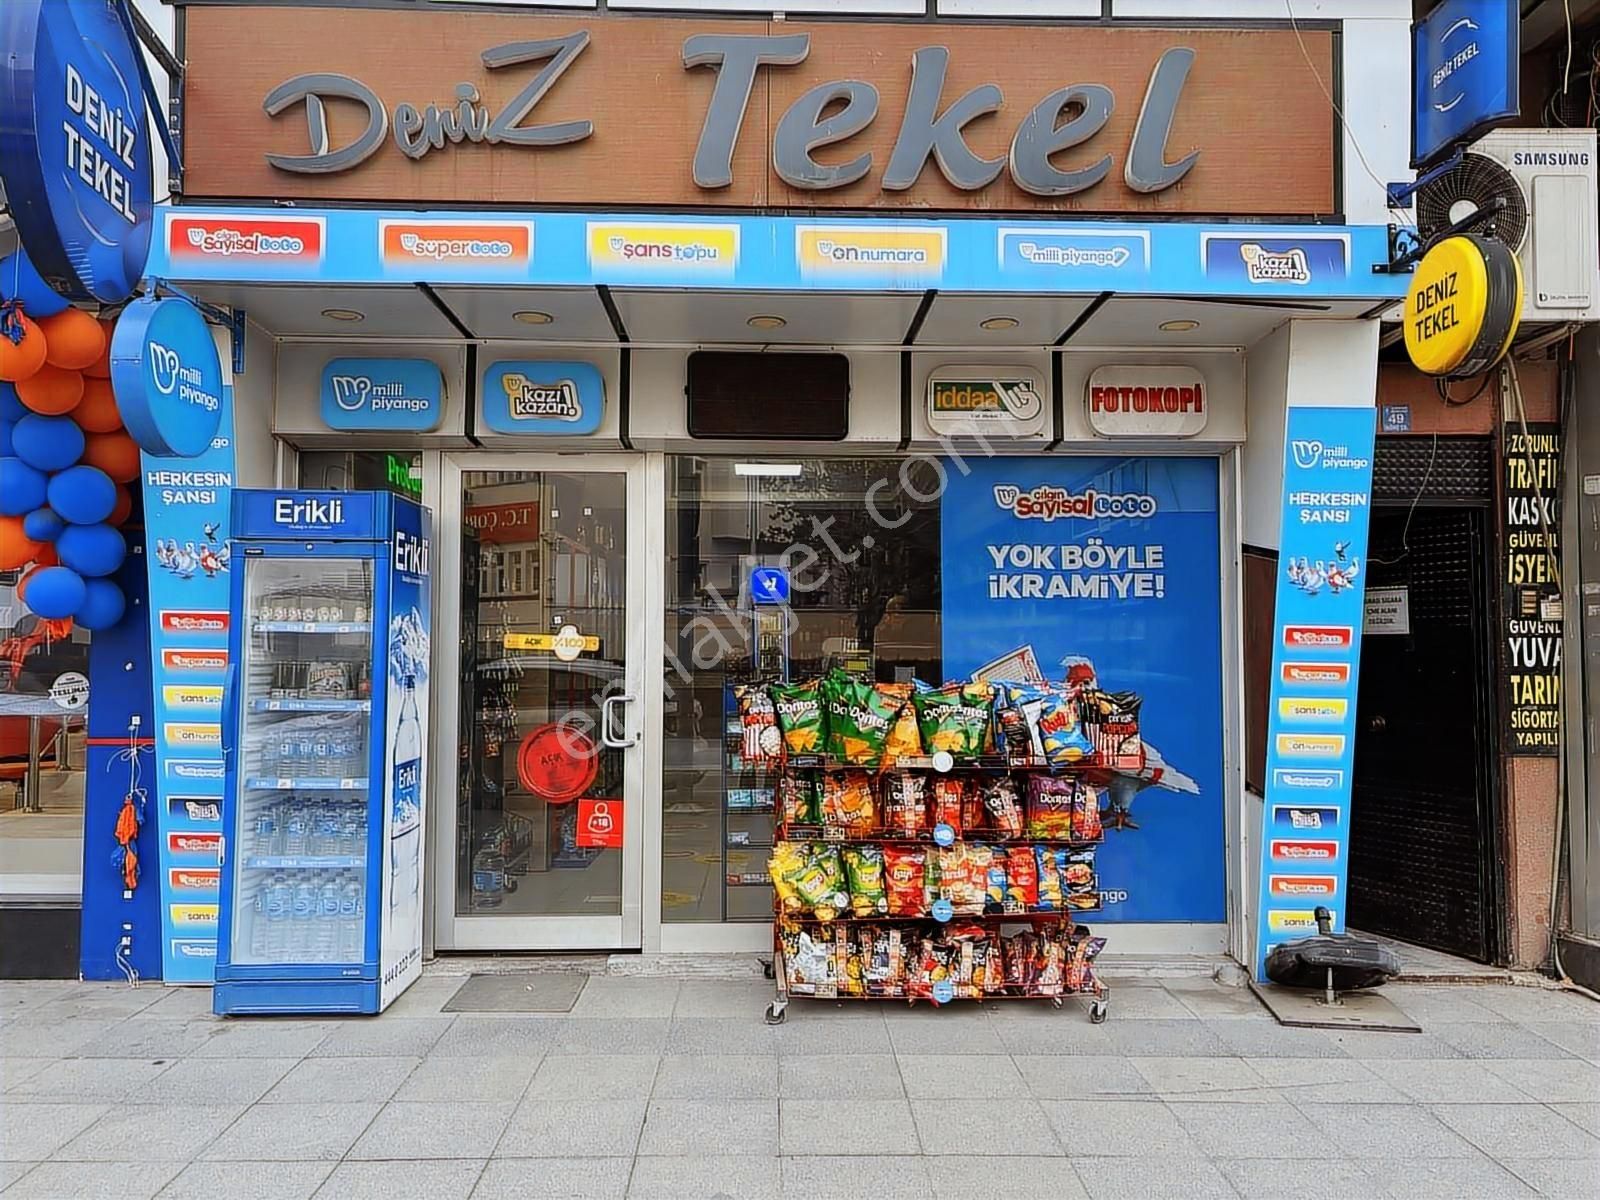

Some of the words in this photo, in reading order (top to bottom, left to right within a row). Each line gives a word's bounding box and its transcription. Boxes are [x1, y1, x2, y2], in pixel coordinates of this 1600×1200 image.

[1432, 59, 1453, 88] DENİZ
[1453, 42, 1480, 72] TEKEL
[64, 63, 136, 171] DENİZ
[682, 32, 1201, 198] Tekel
[1514, 152, 1589, 166] SAMSUNG
[63, 119, 137, 225] TEKEL
[860, 249, 924, 262] numara
[1061, 249, 1113, 266] piyango
[1416, 271, 1459, 314] DENİZ
[1415, 308, 1460, 343] TEKEL
[179, 366, 203, 387] milli
[179, 387, 219, 413] piyango
[372, 383, 403, 396] milli
[936, 386, 1000, 408] iddaa
[372, 396, 429, 411] piyango
[1323, 446, 1348, 457] milli
[1322, 458, 1368, 470] piyango
[162, 489, 216, 506] ŞANSI
[1300, 509, 1349, 525] ŞANSI
[987, 545, 1055, 569] YOK
[1062, 539, 1164, 570] BÖYLE
[777, 699, 818, 714] Doritos
[849, 706, 889, 729] Doritos
